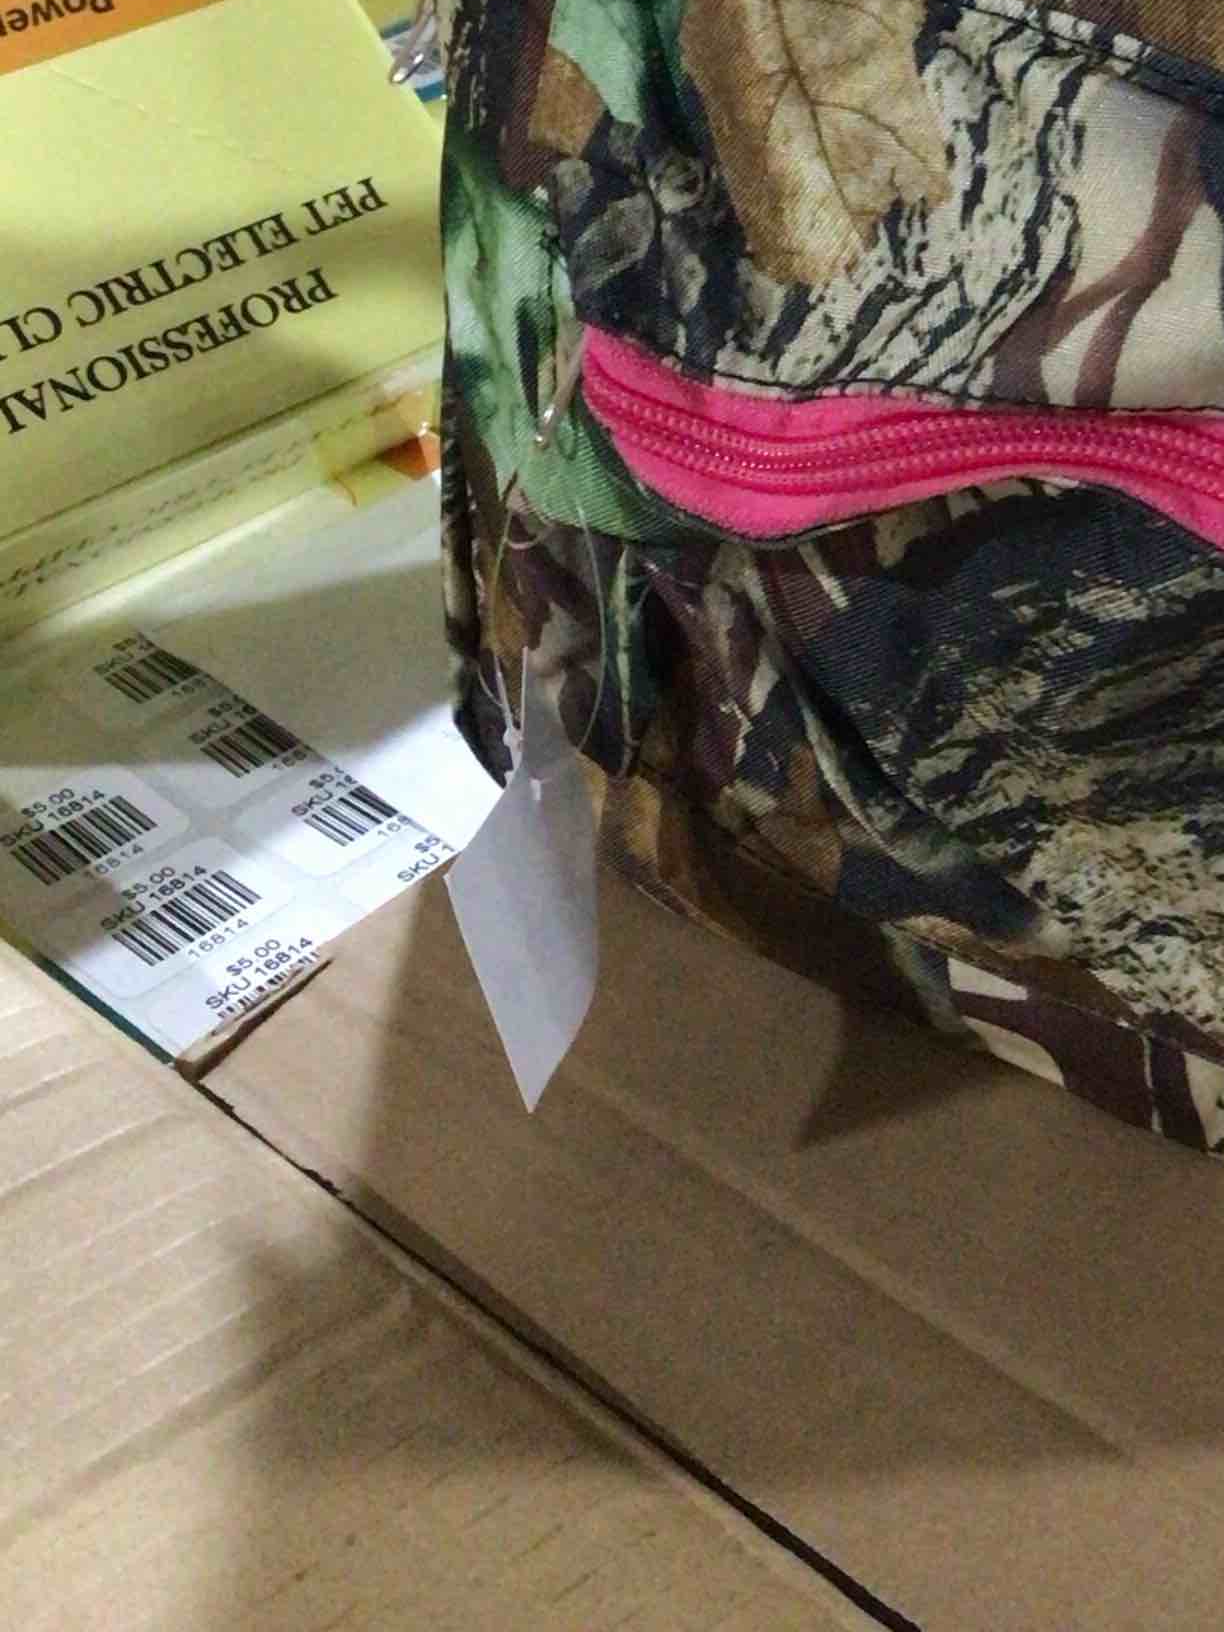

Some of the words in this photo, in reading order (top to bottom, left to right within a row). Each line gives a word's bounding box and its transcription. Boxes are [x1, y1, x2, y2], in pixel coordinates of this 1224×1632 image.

[301, 176, 388, 236] PET
[66, 212, 300, 328] ELECTRIC
[0, 820, 44, 848] SKU
[47, 789, 106, 822] 16814
[20, 788, 76, 818] $5.00
[291, 789, 334, 816] SKU
[121, 866, 177, 901] $5.00
[397, 854, 440, 884] SKU
[100, 900, 147, 932] SKU
[148, 865, 208, 903] 16814
[186, 918, 250, 960] 16814
[225, 938, 282, 977] $5.00
[204, 976, 252, 1011] SKU
[253, 936, 315, 978] 16814
